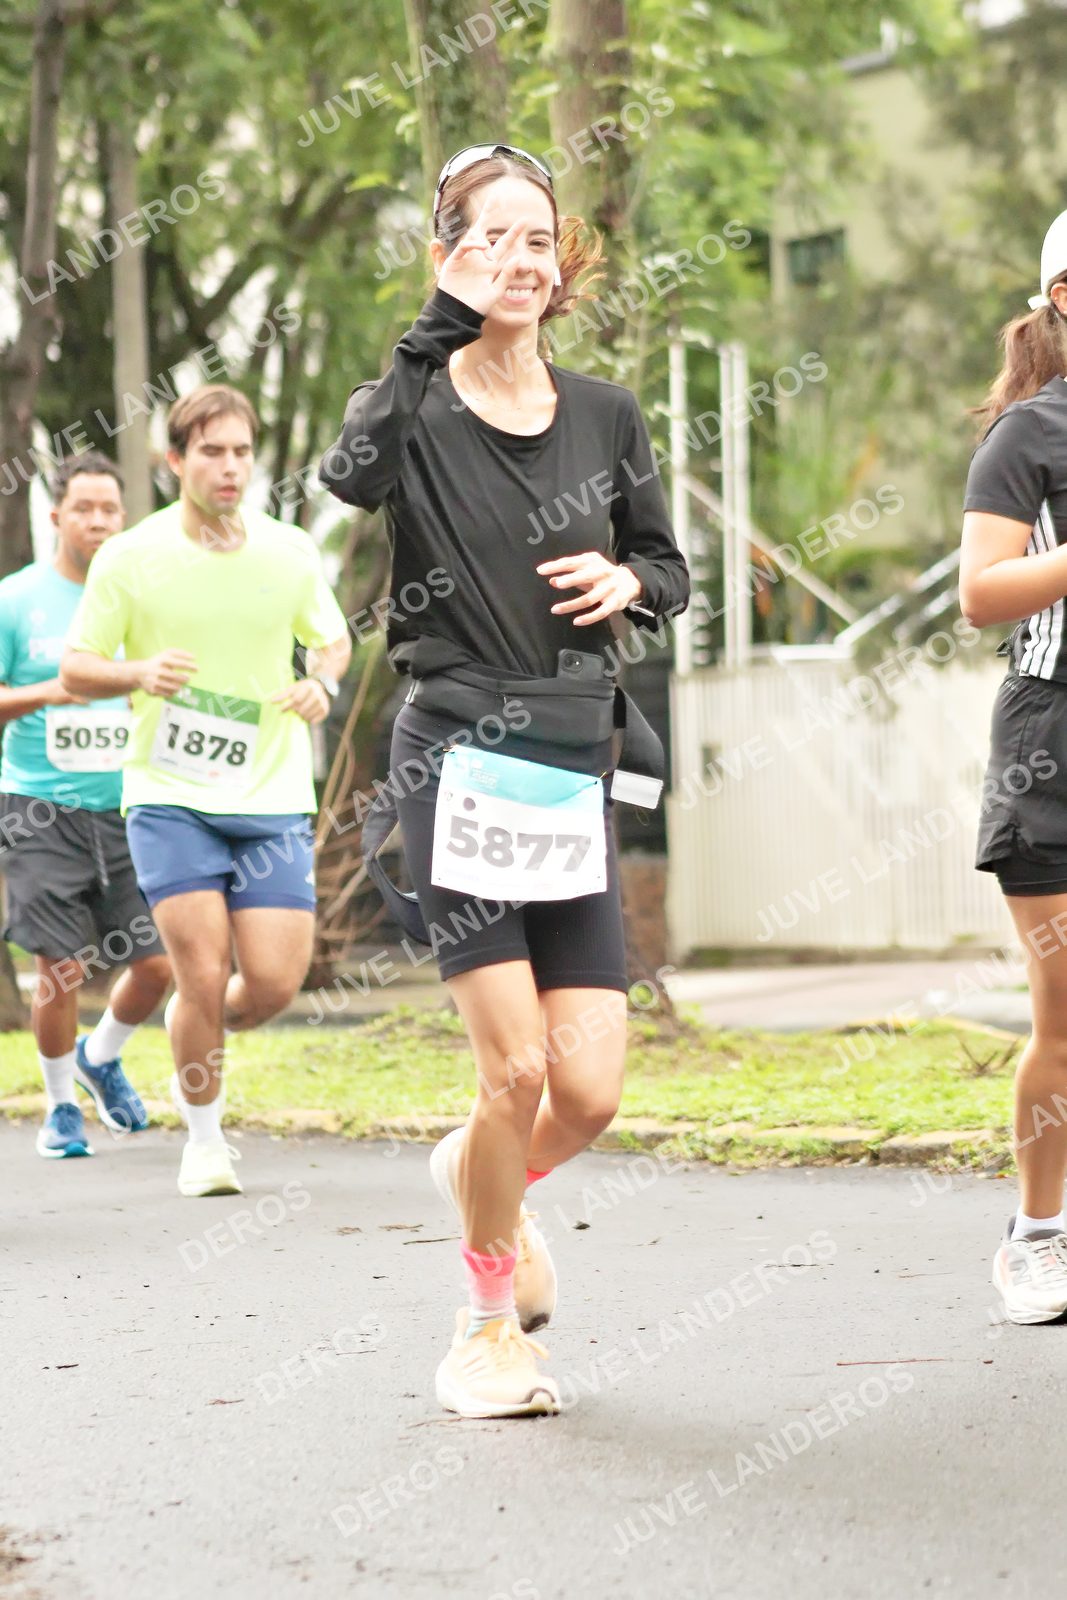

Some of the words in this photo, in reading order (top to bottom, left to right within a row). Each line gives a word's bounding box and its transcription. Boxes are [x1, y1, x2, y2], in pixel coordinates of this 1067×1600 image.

[55, 727, 129, 749] 5059
[168, 723, 247, 766] 1878
[446, 815, 592, 872] 5877
